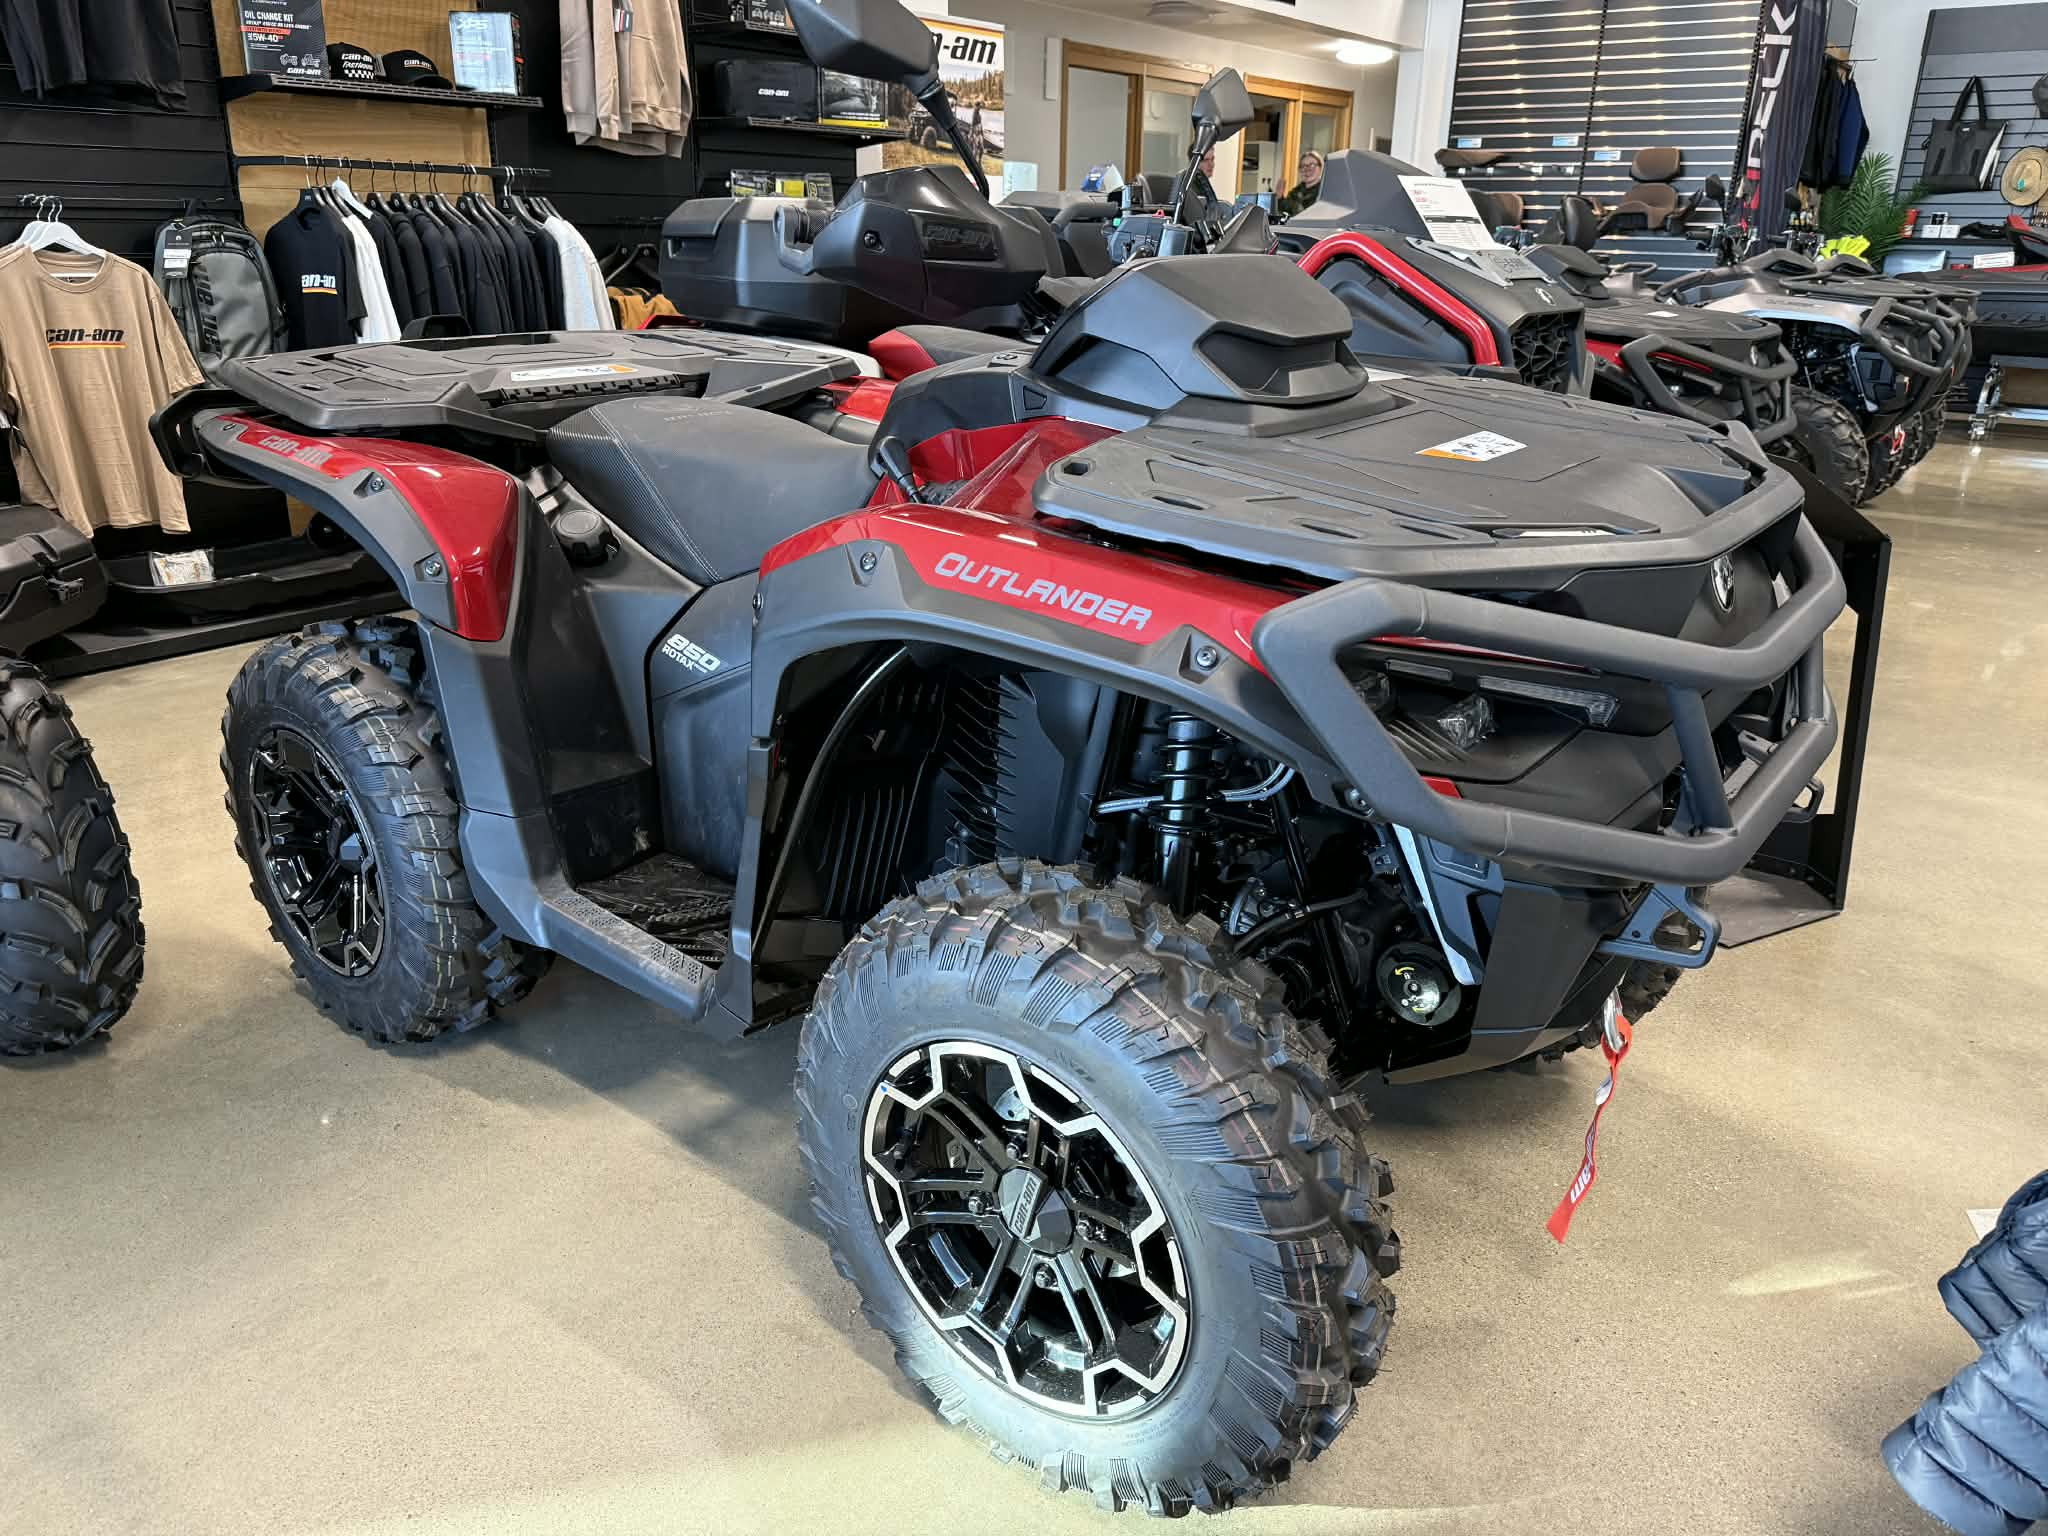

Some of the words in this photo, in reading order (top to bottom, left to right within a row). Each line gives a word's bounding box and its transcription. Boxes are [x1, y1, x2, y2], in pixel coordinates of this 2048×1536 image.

[244, 10, 256, 20] OIL
[256, 11, 283, 22] CHANGE
[283, 13, 294, 23] KIT
[286, 67, 321, 76] can-am
[758, 88, 790, 97] can-am
[45, 328, 125, 342] can-am
[258, 434, 334, 466] can-am
[933, 551, 1153, 631] OUTLANDER
[666, 633, 721, 672] 850
[1013, 1175, 1039, 1235] can-am
